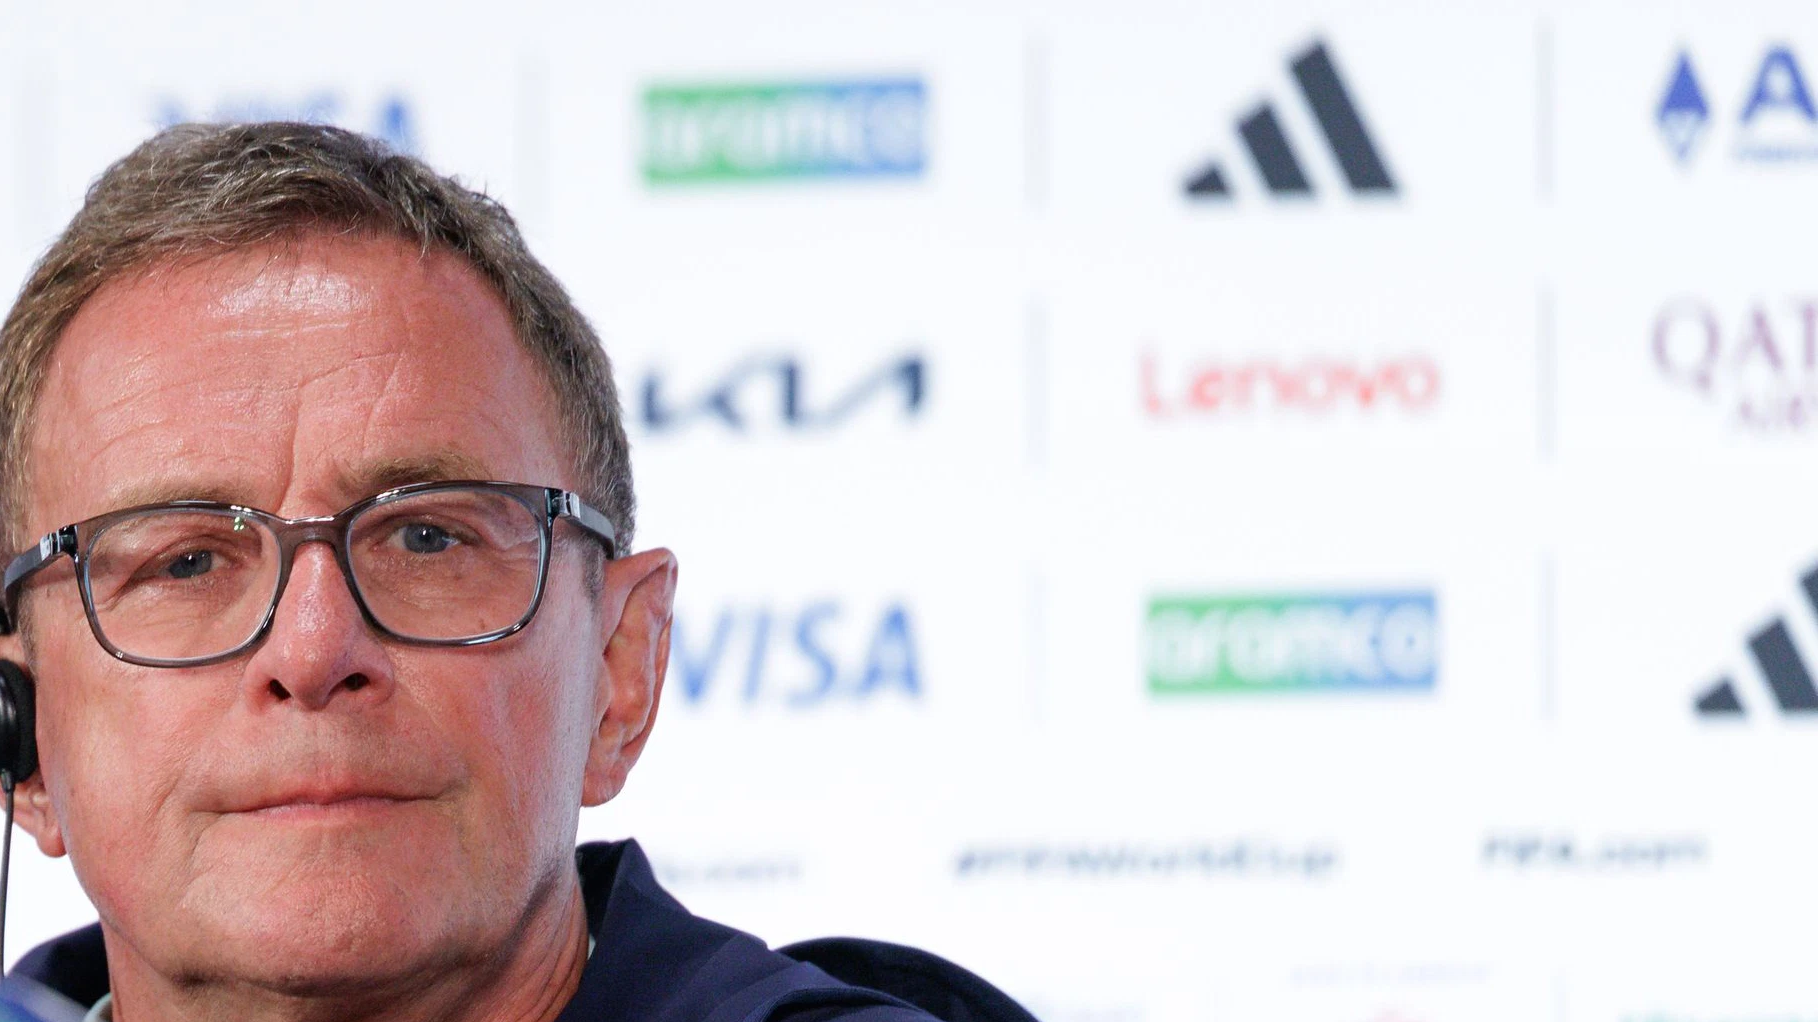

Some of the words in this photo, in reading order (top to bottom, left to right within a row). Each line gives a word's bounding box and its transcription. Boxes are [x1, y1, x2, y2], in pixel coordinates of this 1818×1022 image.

[1138, 345, 1442, 418] Lenovo
[670, 600, 926, 708] VISA
[1150, 606, 1436, 686] aramco
